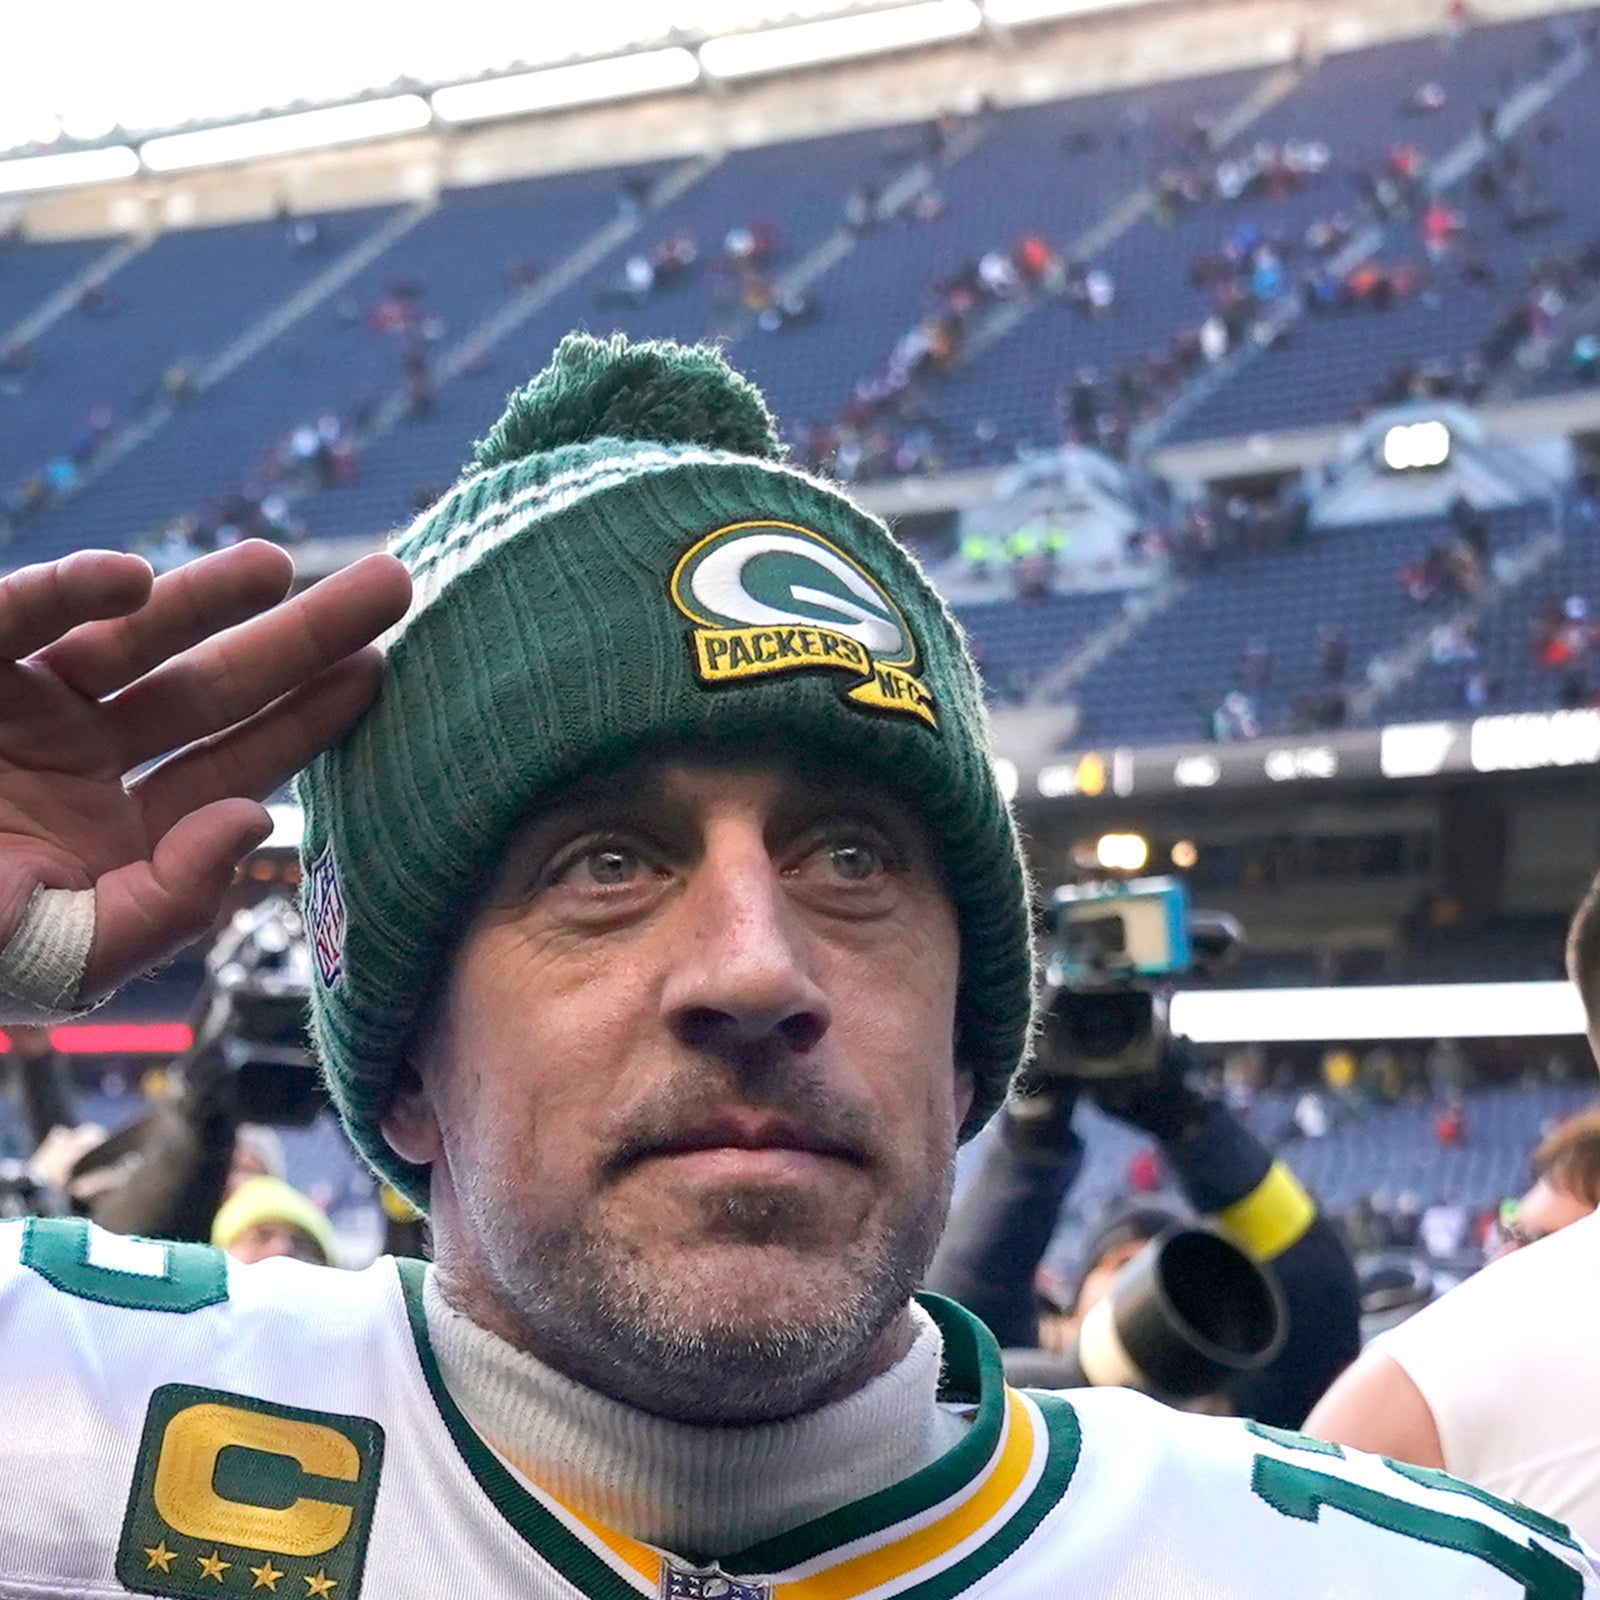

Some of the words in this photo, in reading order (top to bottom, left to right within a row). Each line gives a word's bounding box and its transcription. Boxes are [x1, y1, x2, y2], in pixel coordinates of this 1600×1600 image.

[691, 534, 902, 654] G
[704, 629, 863, 671] PACKERS
[875, 670, 921, 702] NFC
[153, 1403, 361, 1557] C
